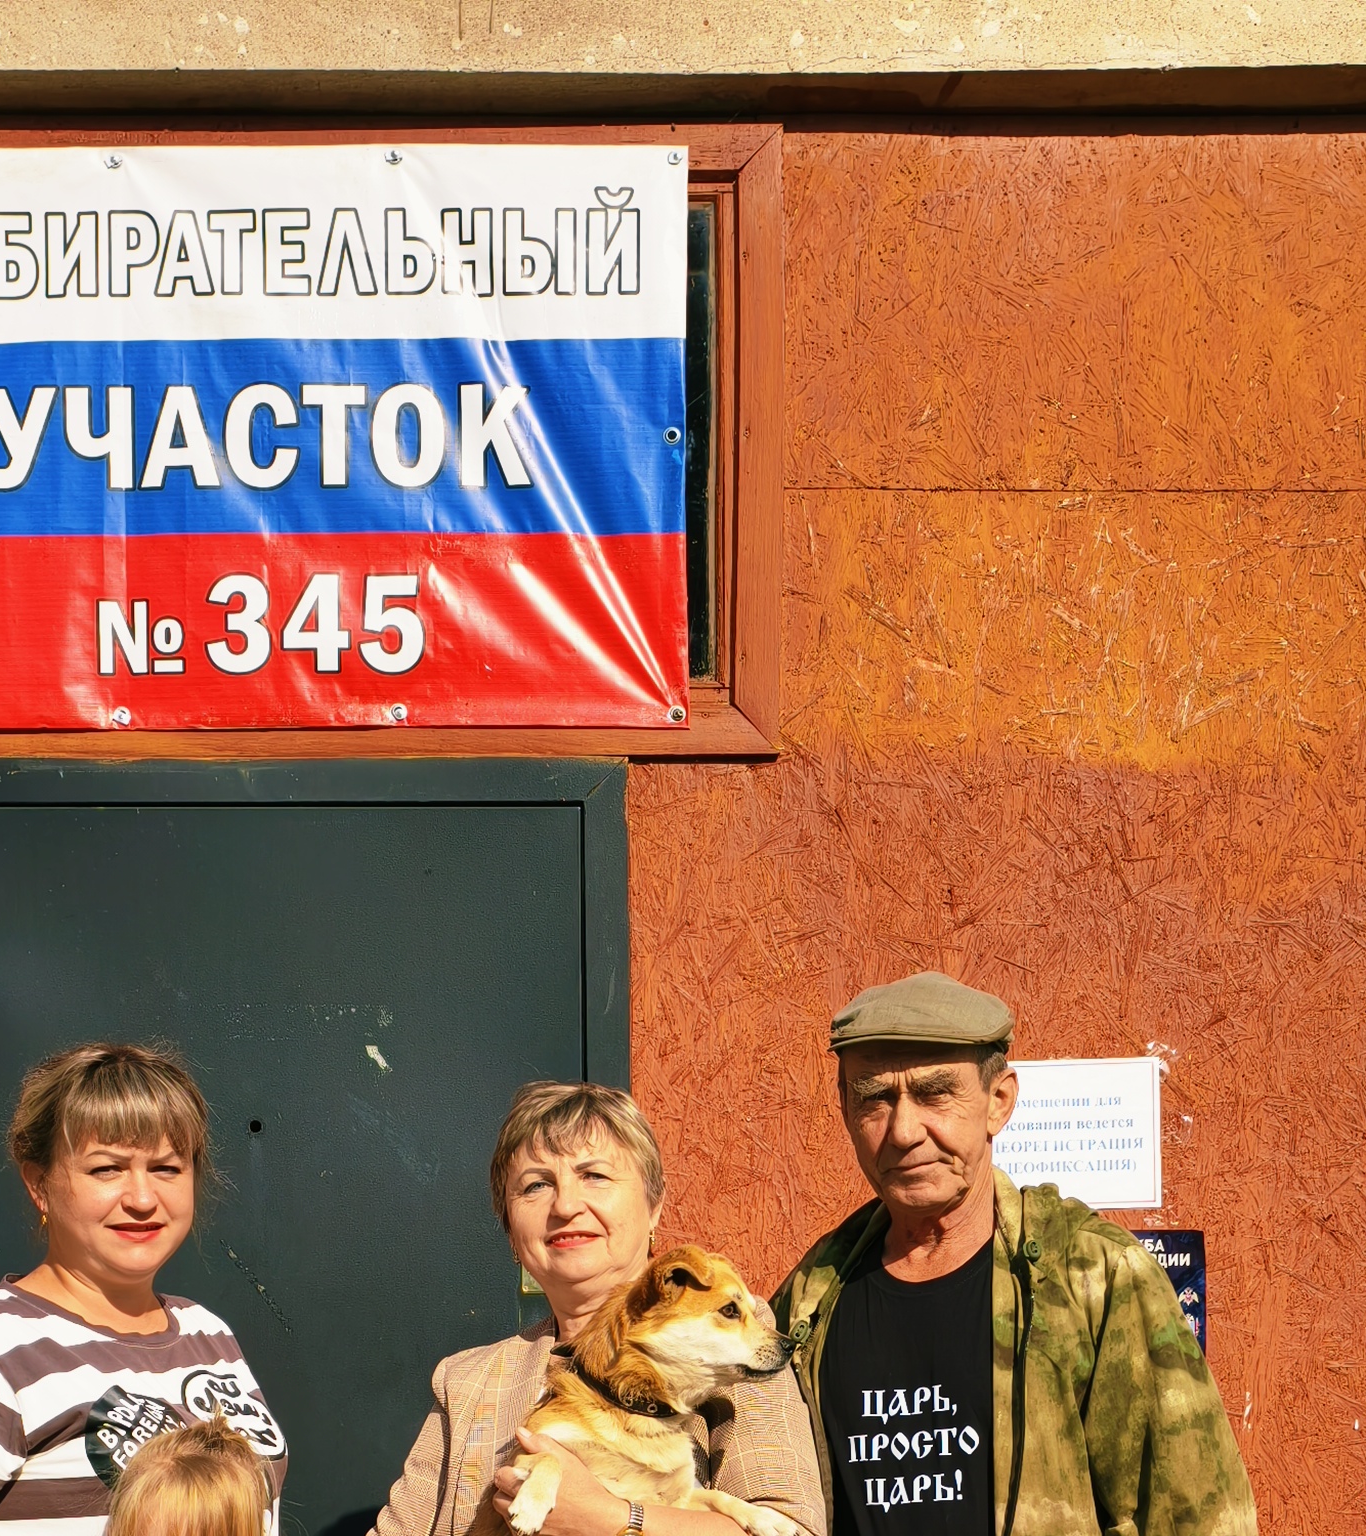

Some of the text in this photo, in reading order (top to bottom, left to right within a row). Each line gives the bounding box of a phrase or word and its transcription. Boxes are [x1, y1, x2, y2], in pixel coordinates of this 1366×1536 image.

[97, 572, 425, 676] № 345
[1094, 1096, 1122, 1107] для
[1077, 1118, 1134, 1130] ведется
[861, 1384, 958, 1425] ЦАРЬ,
[848, 1425, 980, 1463] ПРОСТО
[864, 1468, 964, 1514] ЦАРЬ!
